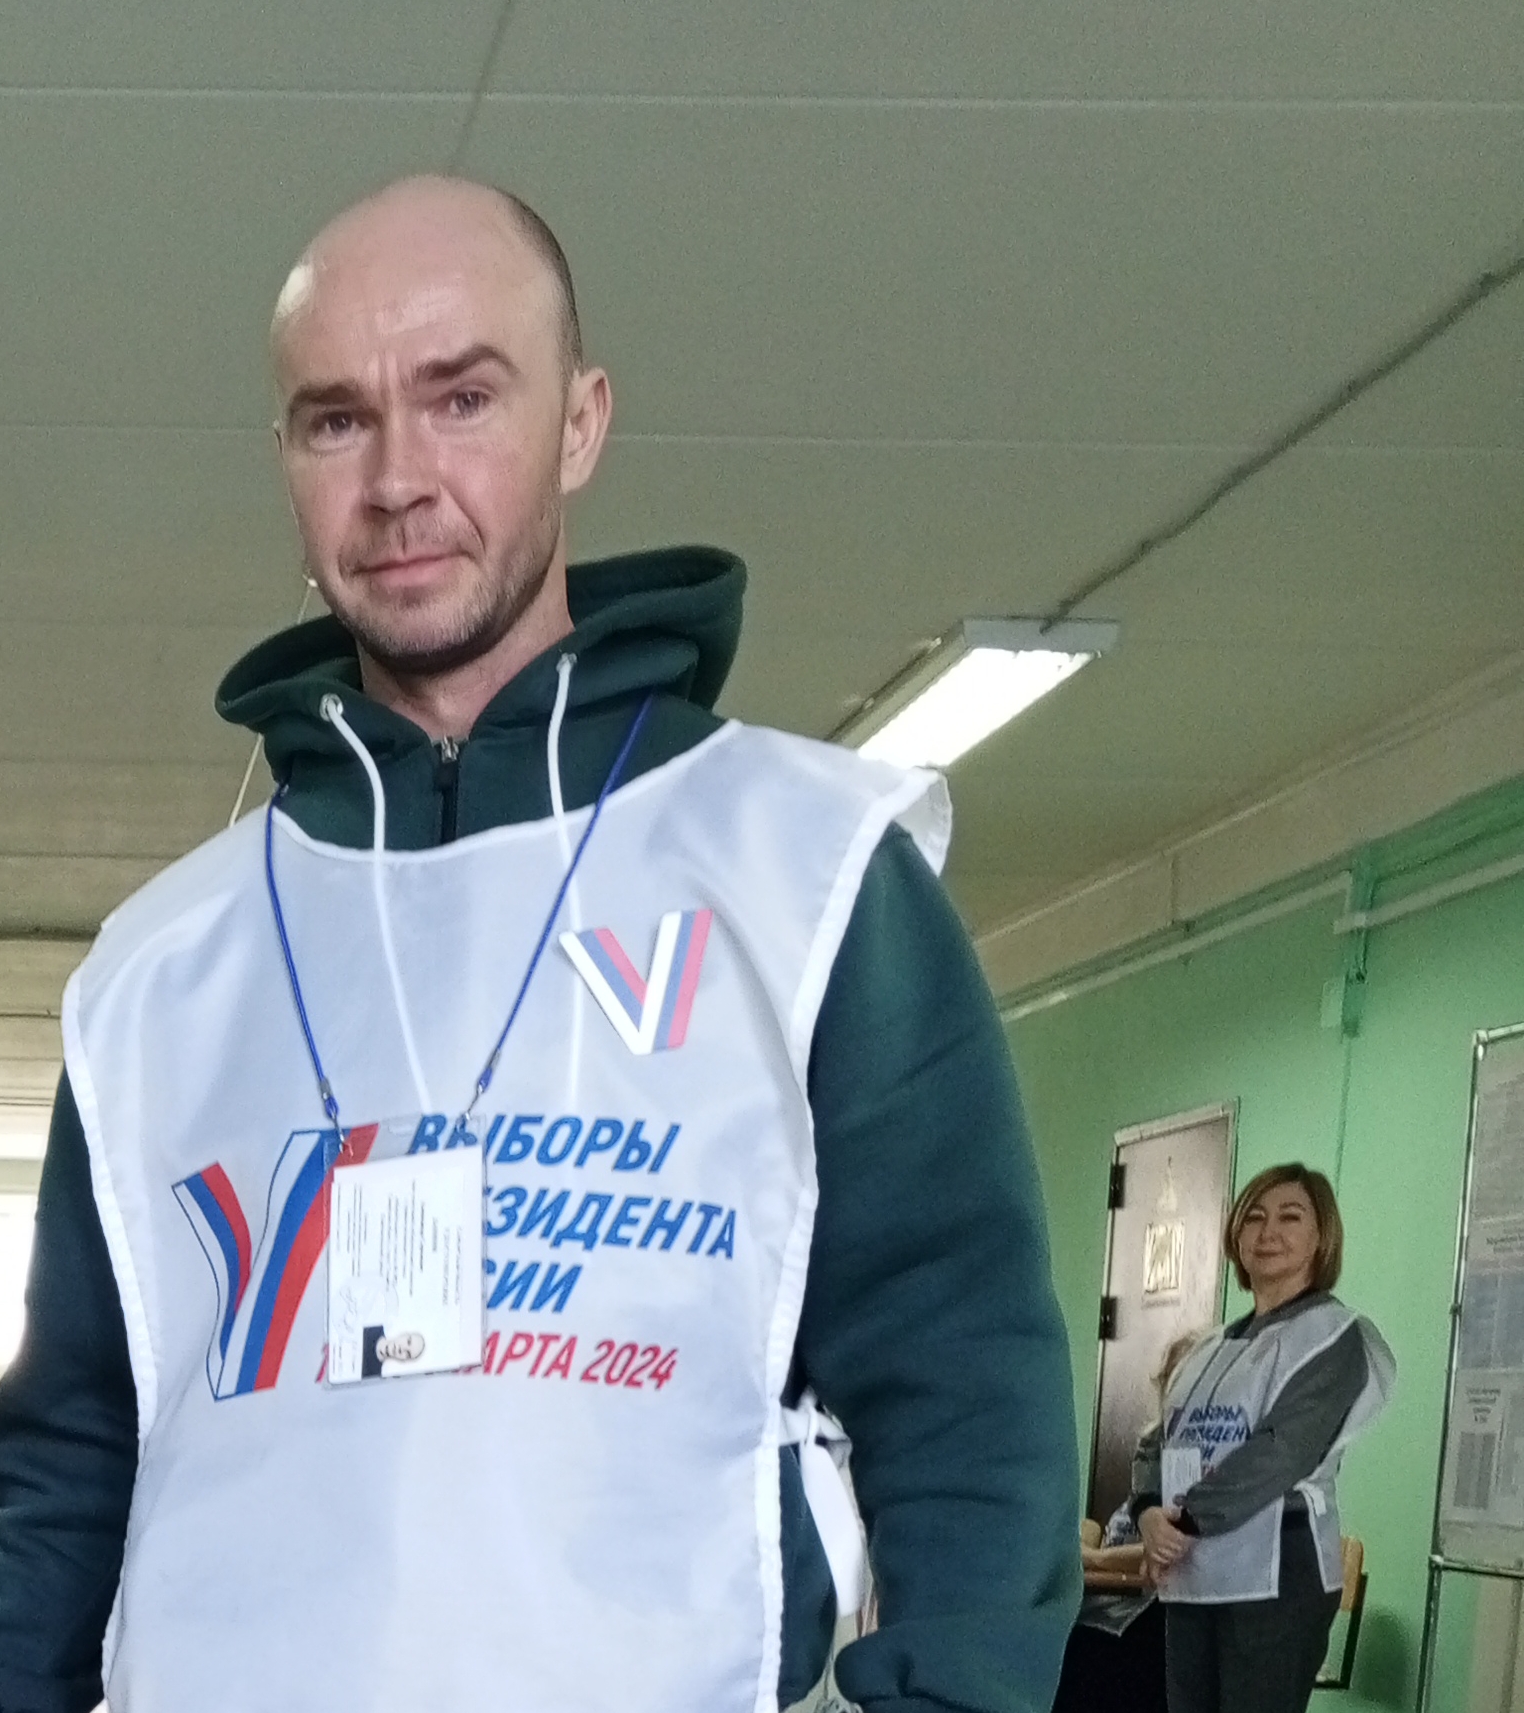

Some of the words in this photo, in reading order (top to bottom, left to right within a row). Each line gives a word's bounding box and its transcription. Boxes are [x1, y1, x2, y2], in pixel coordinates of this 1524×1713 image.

[482, 1186, 737, 1261] ЗИДЕНТА
[454, 1330, 578, 1381] АРТА
[579, 1338, 680, 1391] 2024
